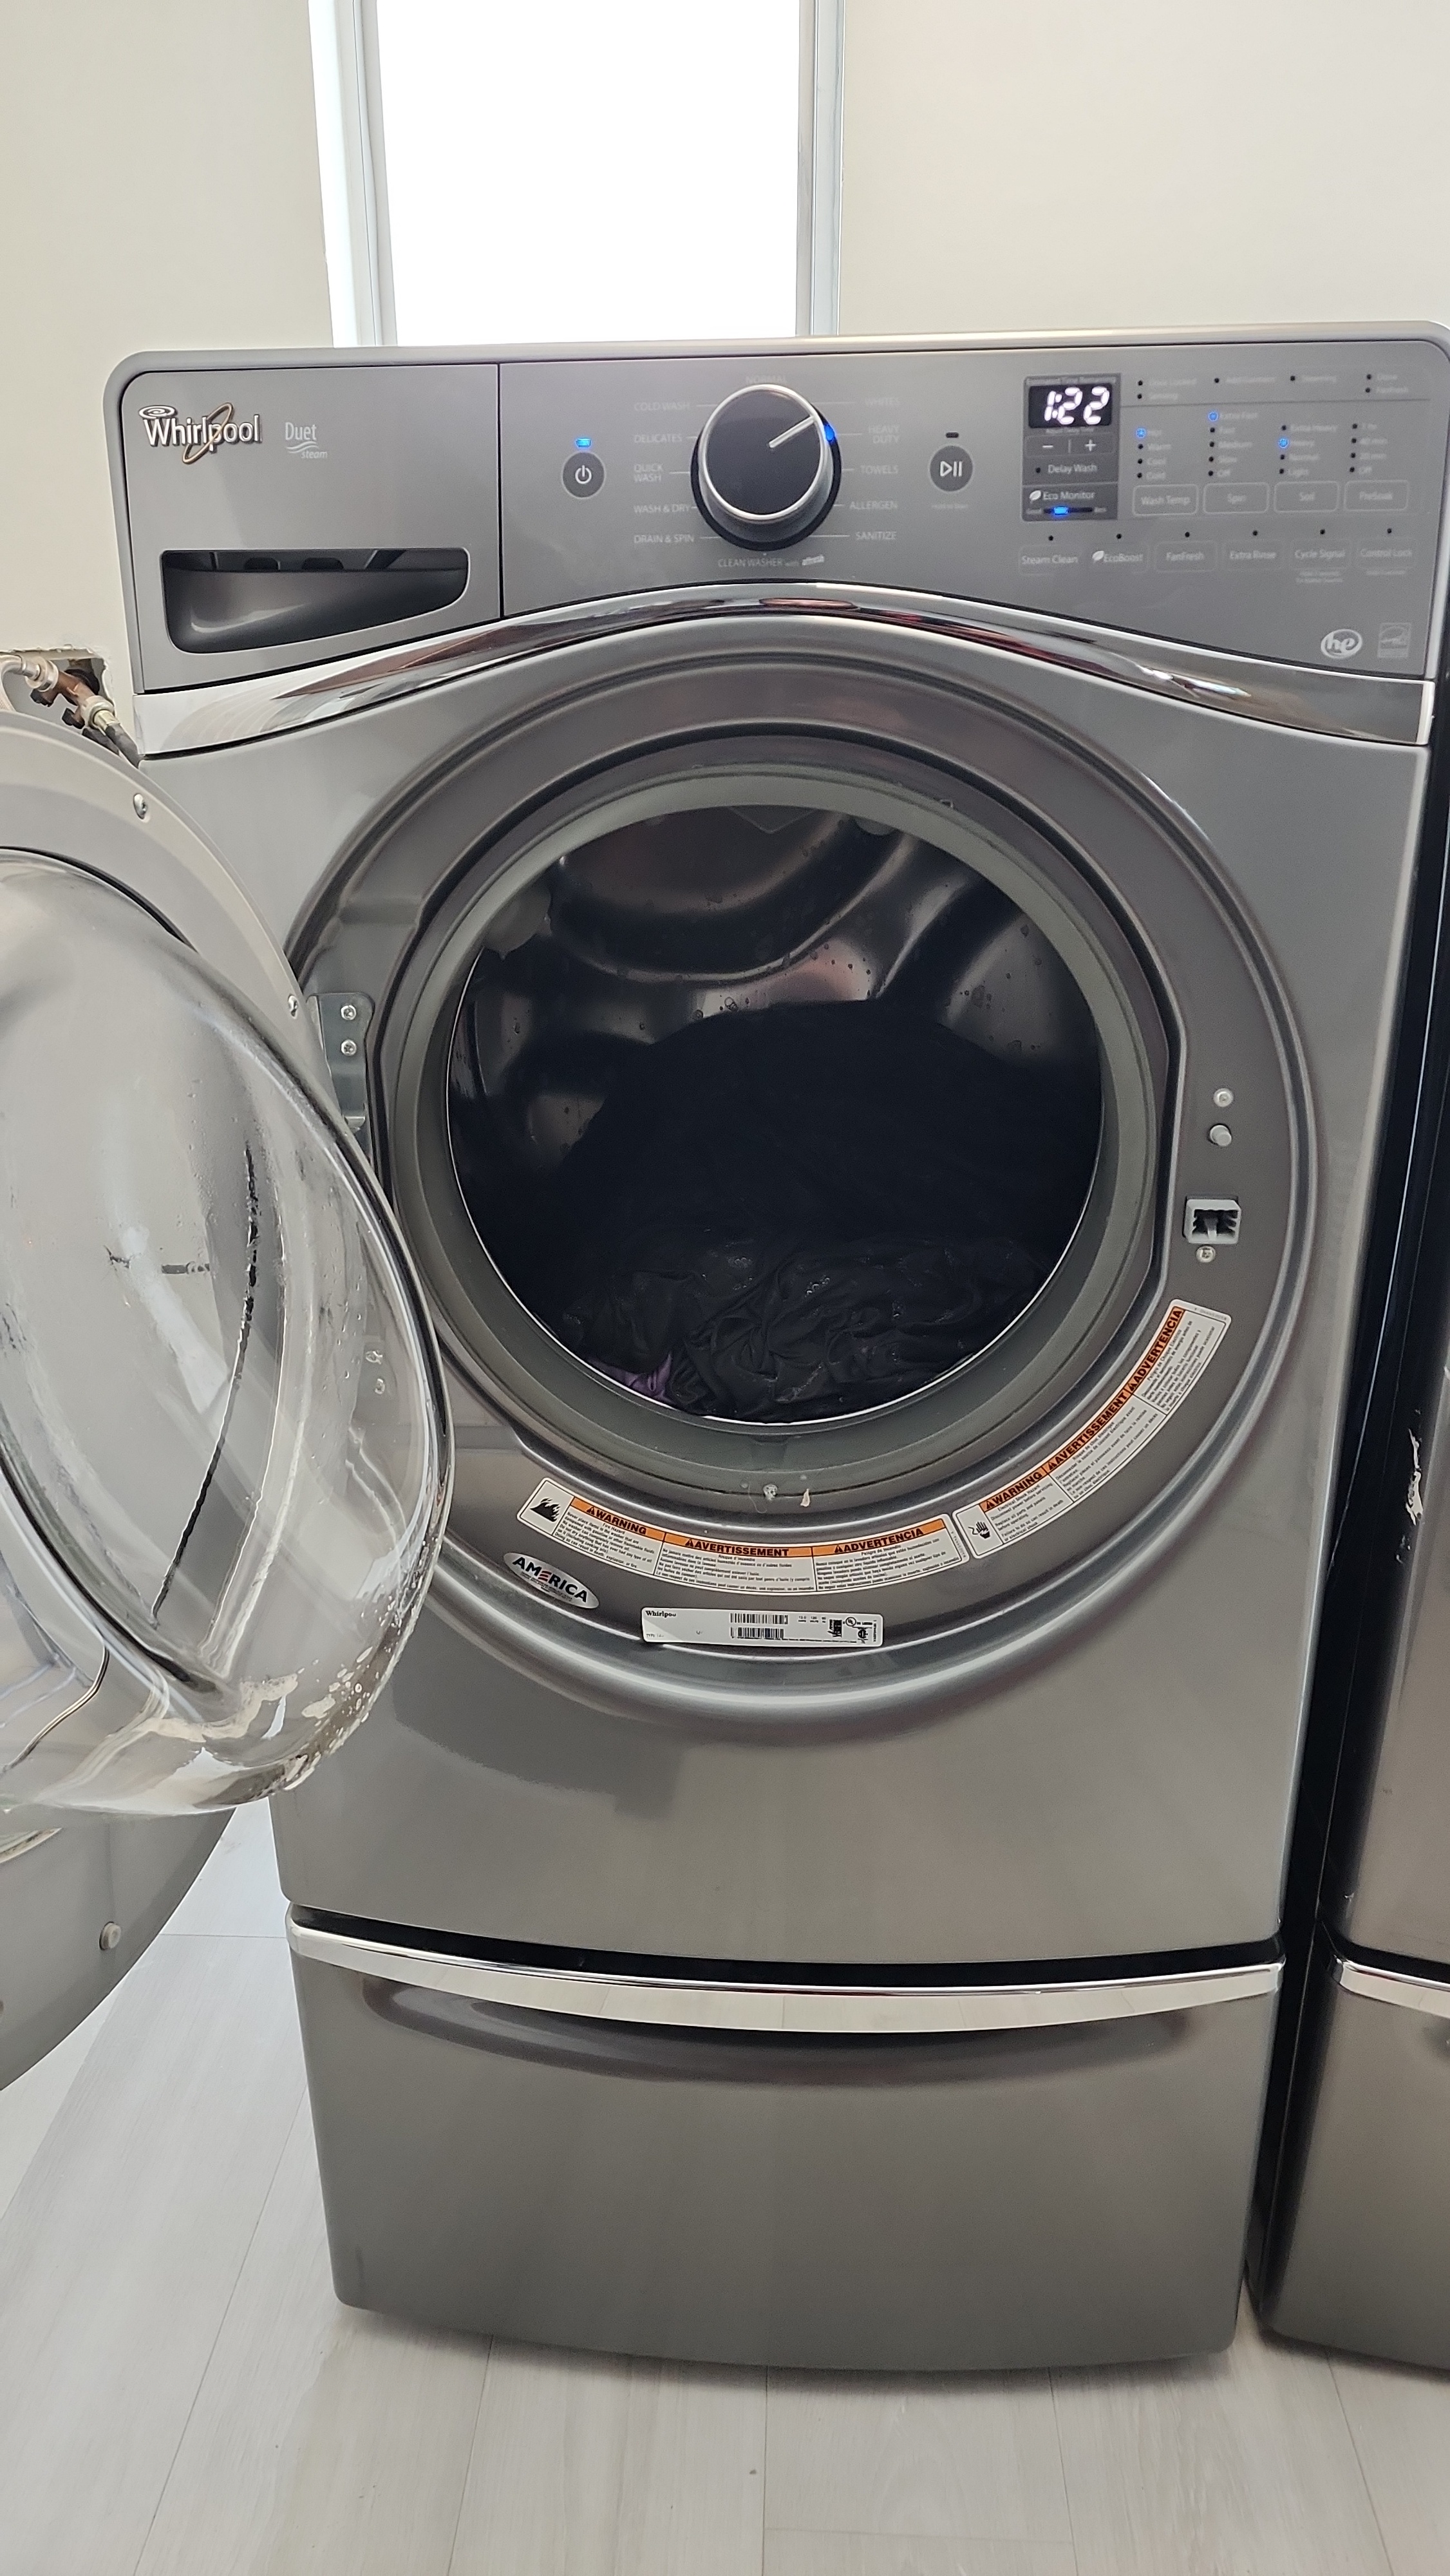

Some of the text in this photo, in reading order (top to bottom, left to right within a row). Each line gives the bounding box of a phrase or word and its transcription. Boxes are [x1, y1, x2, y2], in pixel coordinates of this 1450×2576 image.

[746, 375, 787, 385] NORMAL
[634, 402, 690, 411] COLD WASH
[865, 397, 900, 406] WHITES
[1044, 386, 1109, 425] 1:22
[143, 414, 262, 453] Whirlpool
[285, 421, 317, 440] Duet
[869, 424, 899, 435] HEAVY
[634, 433, 682, 443] DELICATES
[872, 433, 899, 444] DUTY
[301, 450, 328, 459] steam
[634, 464, 663, 474] QUICK
[860, 465, 898, 474] TOWELS
[1048, 464, 1072, 474] Delay
[634, 472, 661, 482] WASH
[1043, 491, 1059, 500] Eco
[1141, 495, 1191, 506] Wash Temp
[671, 504, 689, 513] DRY
[850, 500, 898, 509] ALLERGEN
[634, 535, 663, 544] DRAIN
[673, 534, 694, 543] SPIN
[856, 531, 896, 540] SANITIZE
[1021, 555, 1078, 564] Steam Clean
[1166, 552, 1204, 561] FanFresh
[1229, 551, 1252, 560] Extra
[1294, 549, 1345, 560] Cycle Signal
[717, 558, 746, 568] CLEAN
[747, 558, 782, 567] WASHER
[1326, 631, 1355, 653] he
[1133, 1311, 1182, 1383] ADVERTENCIA
[1055, 1392, 1126, 1464] AVERTISSEMENT
[992, 1472, 1042, 1504] WARNING
[596, 1509, 646, 1534] WARNING
[843, 1528, 923, 1551] ADVERTENCIA
[694, 1541, 788, 1556] AVERTISSEMENT
[512, 1557, 587, 1603] AMERICA
